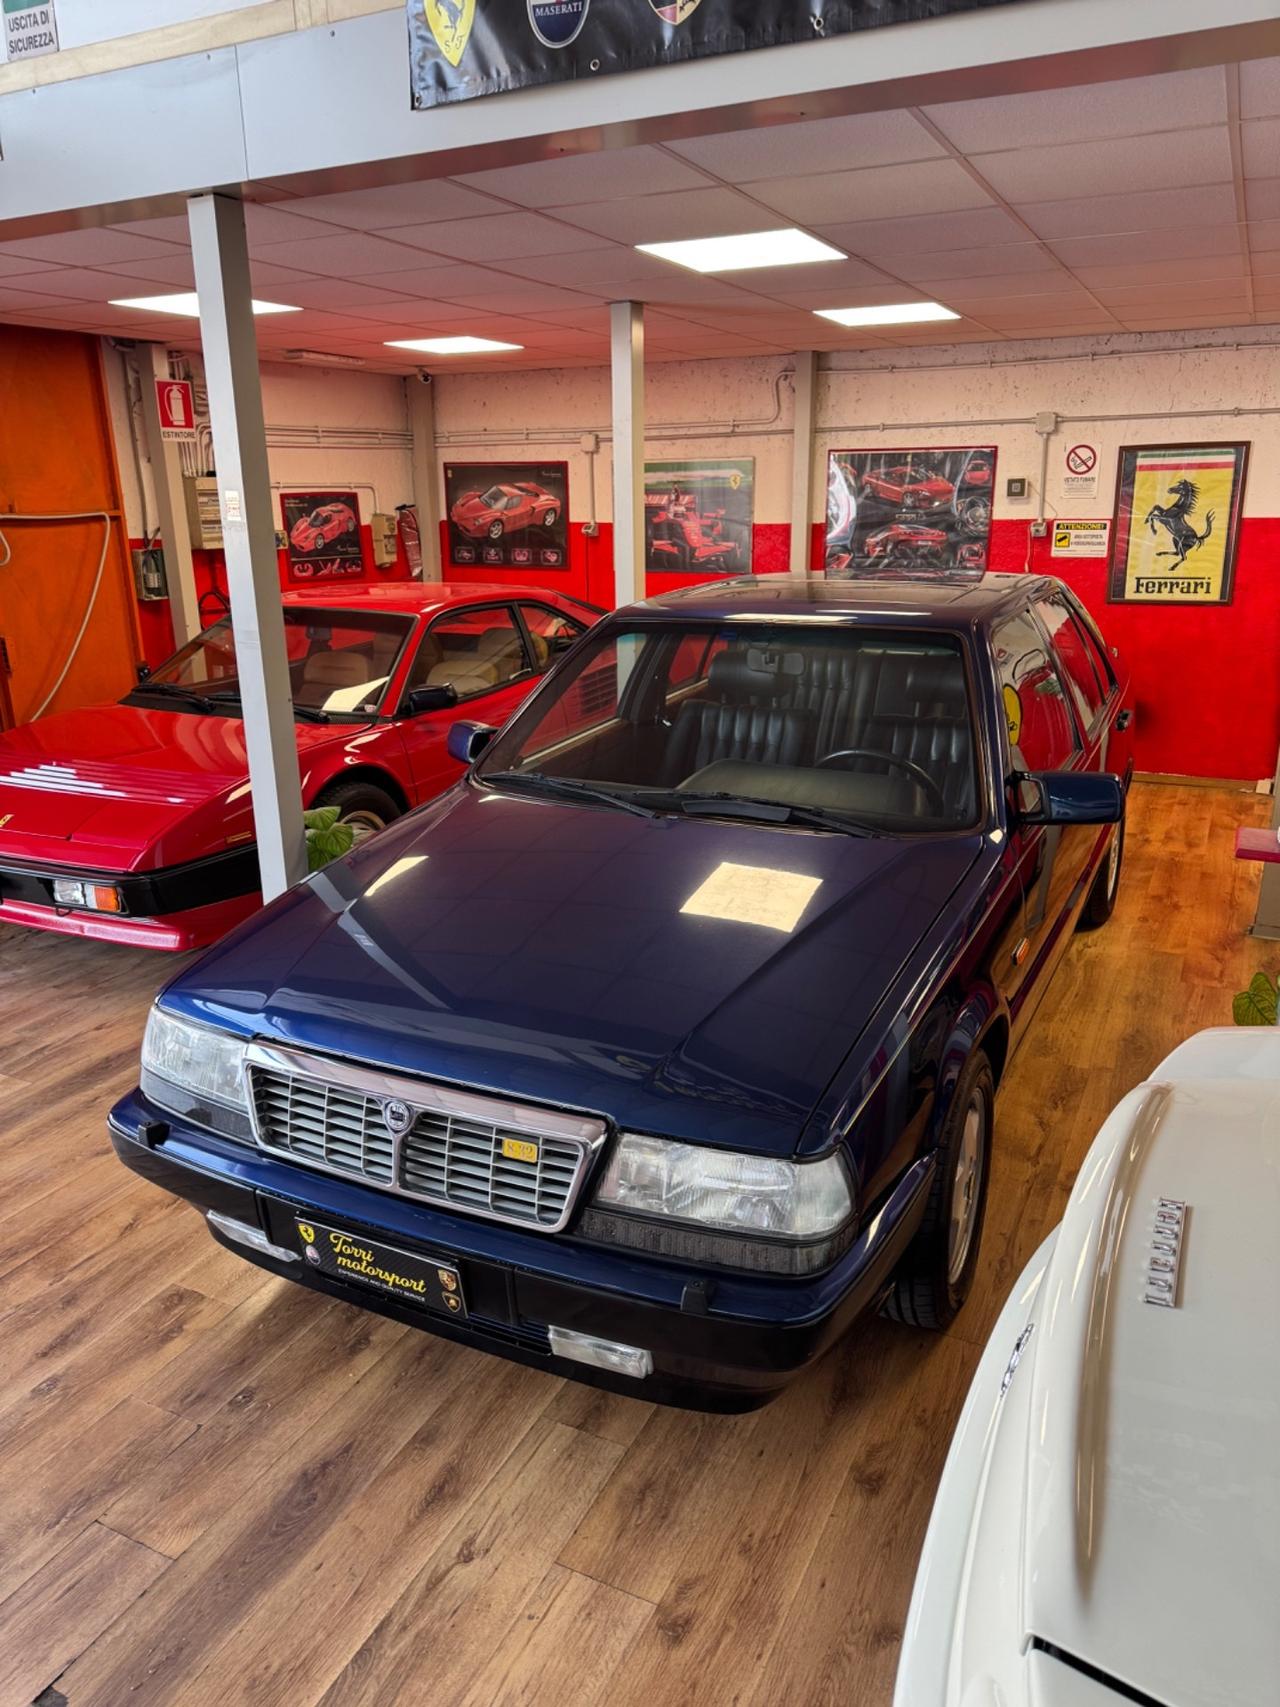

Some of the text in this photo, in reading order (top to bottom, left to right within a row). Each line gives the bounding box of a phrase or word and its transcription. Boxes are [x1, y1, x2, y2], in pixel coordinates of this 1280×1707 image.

[8, 9, 50, 32] USCITA DI
[535, 2, 582, 16] MASERATI
[9, 31, 55, 54] SICUREZZA
[162, 431, 196, 439] ESTINTORE
[1133, 577, 1212, 594] Ferrari
[329, 1232, 375, 1262] Torri
[337, 1255, 427, 1293] motorsport
